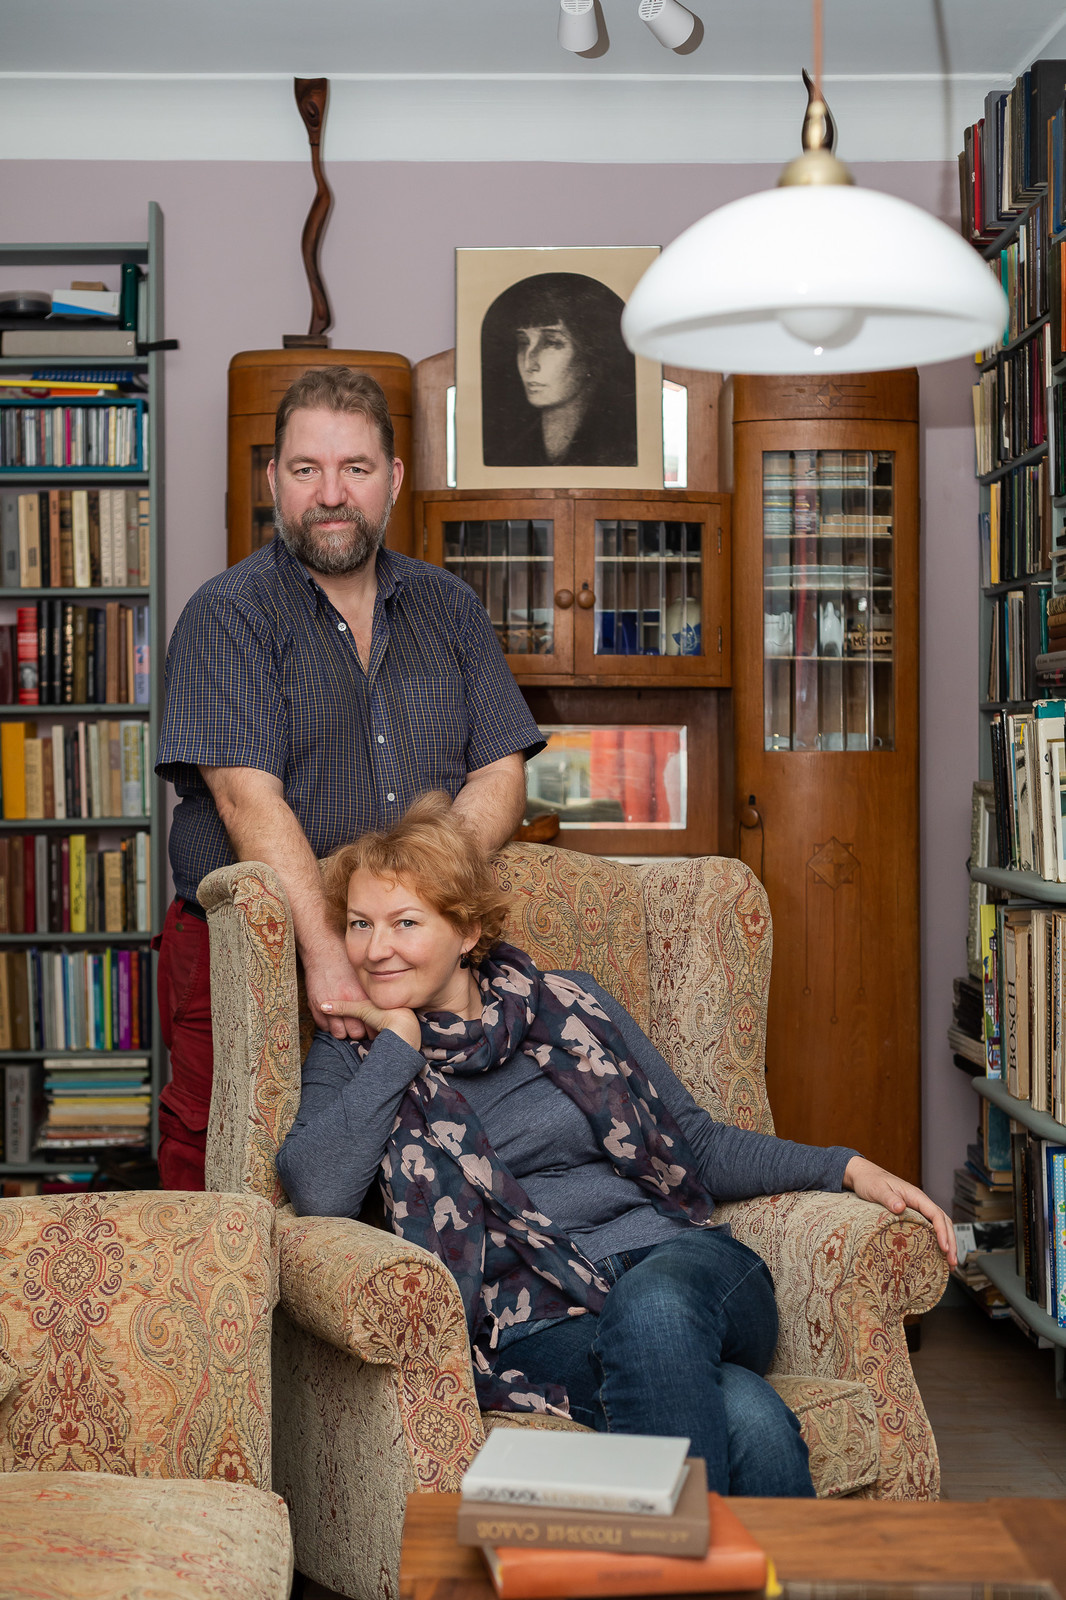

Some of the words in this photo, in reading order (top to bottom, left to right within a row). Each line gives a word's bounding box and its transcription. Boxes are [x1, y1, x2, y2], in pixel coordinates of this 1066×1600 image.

[1008, 981, 1017, 1070] BOSCH
[476, 1520, 540, 1541] САДОВ
[547, 1524, 623, 1545] ПОЭЗИЯ
